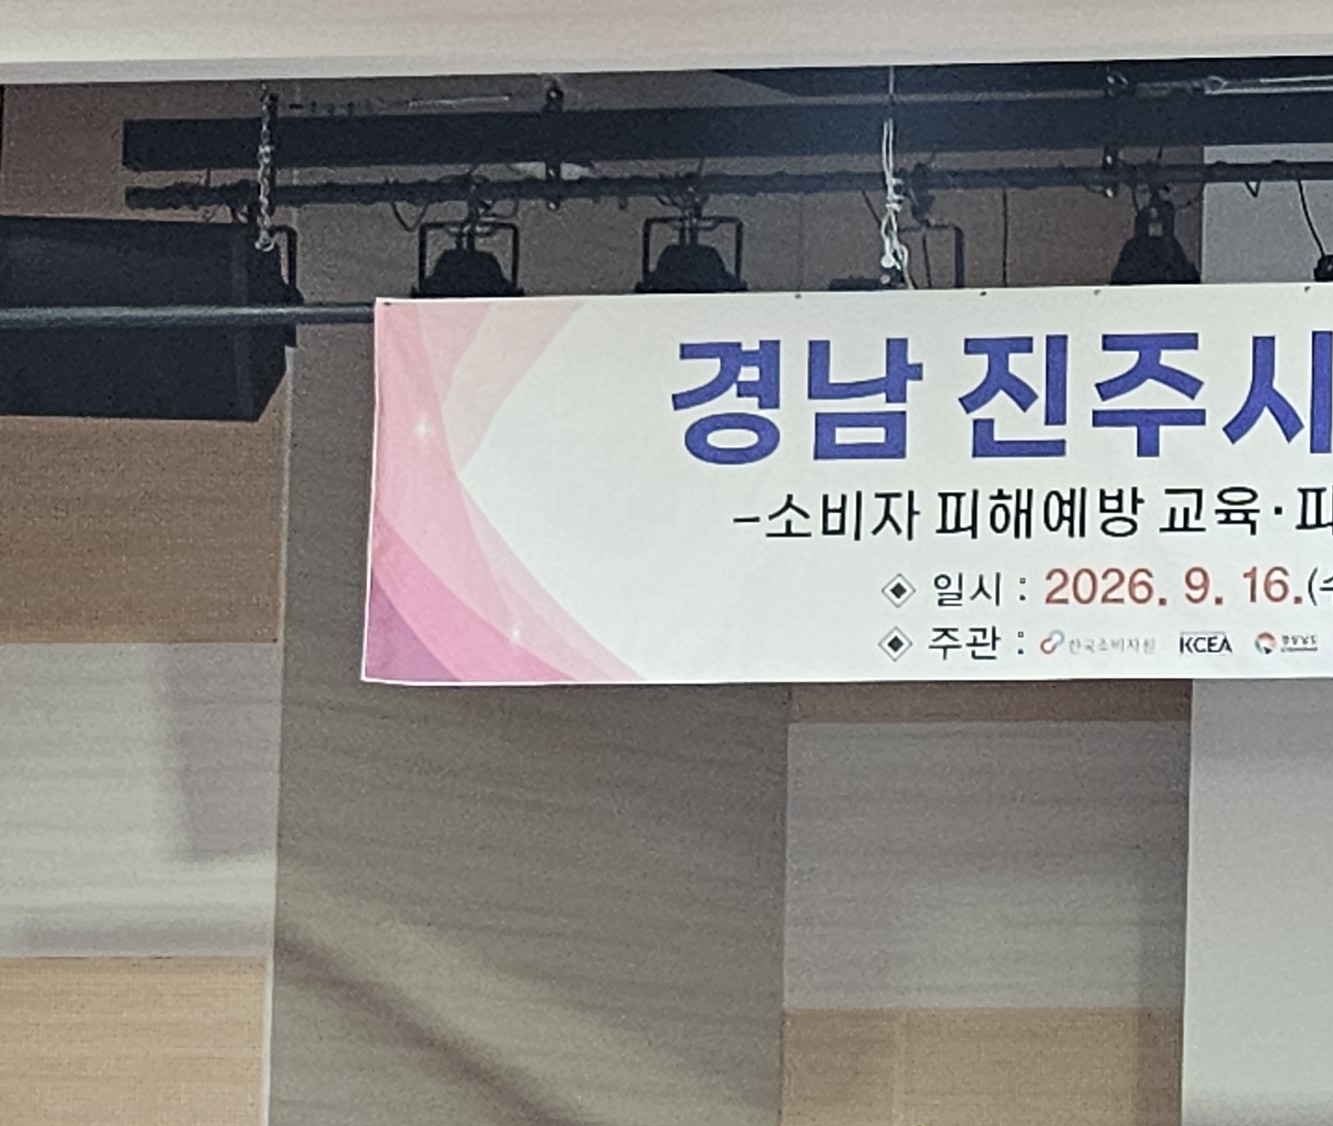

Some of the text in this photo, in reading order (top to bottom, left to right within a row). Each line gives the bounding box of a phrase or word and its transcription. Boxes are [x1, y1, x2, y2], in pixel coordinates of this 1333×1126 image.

[671, 337, 923, 465] 경남
[958, 330, 1333, 458] 진주시
[935, 486, 1145, 540] 피해예방
[934, 572, 1001, 607] 일시
[1045, 568, 1167, 606] 2026.
[1185, 567, 1223, 605] 9.
[928, 625, 1002, 661] 주관
[1179, 636, 1232, 653] KCEA
